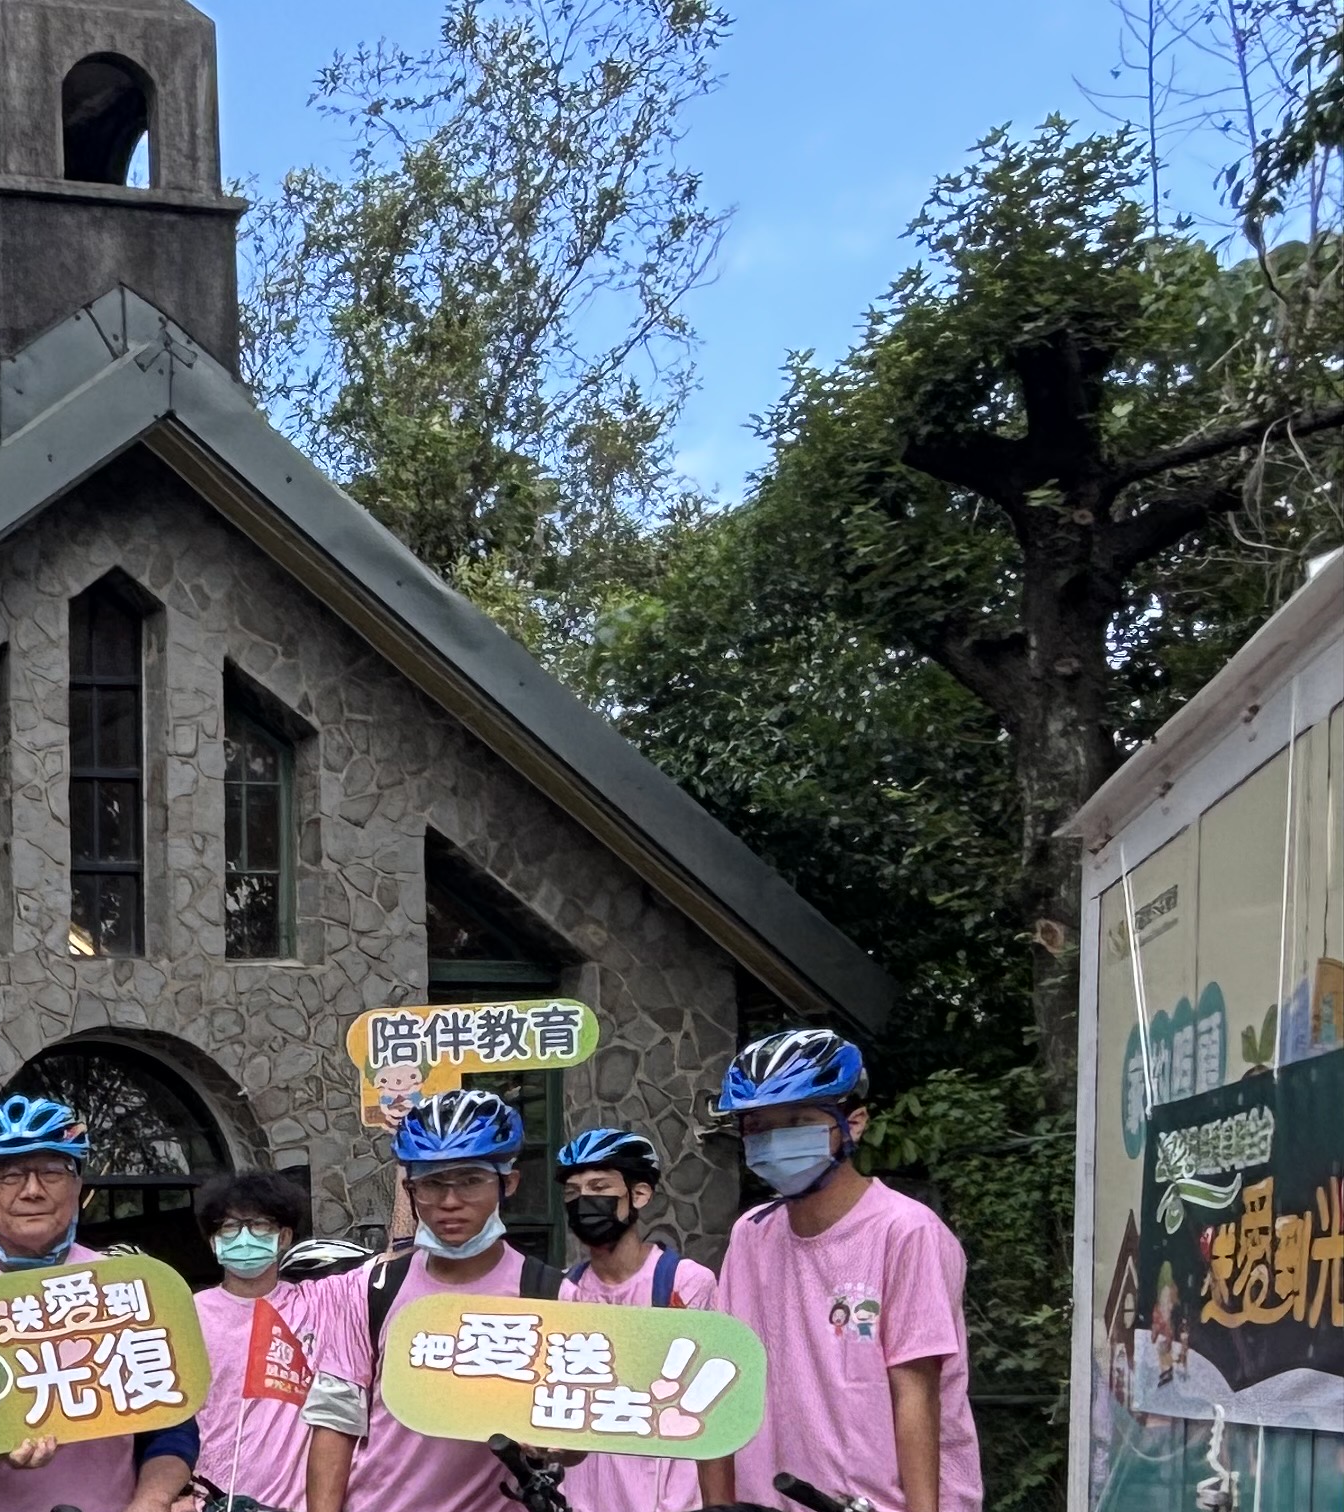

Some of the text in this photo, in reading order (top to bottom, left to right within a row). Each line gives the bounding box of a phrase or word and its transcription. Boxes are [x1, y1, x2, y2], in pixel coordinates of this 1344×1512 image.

[371, 1005, 580, 1066] 陪伴教育
[15, 1328, 184, 1425] 光復
[410, 1313, 614, 1384] 把愛送
